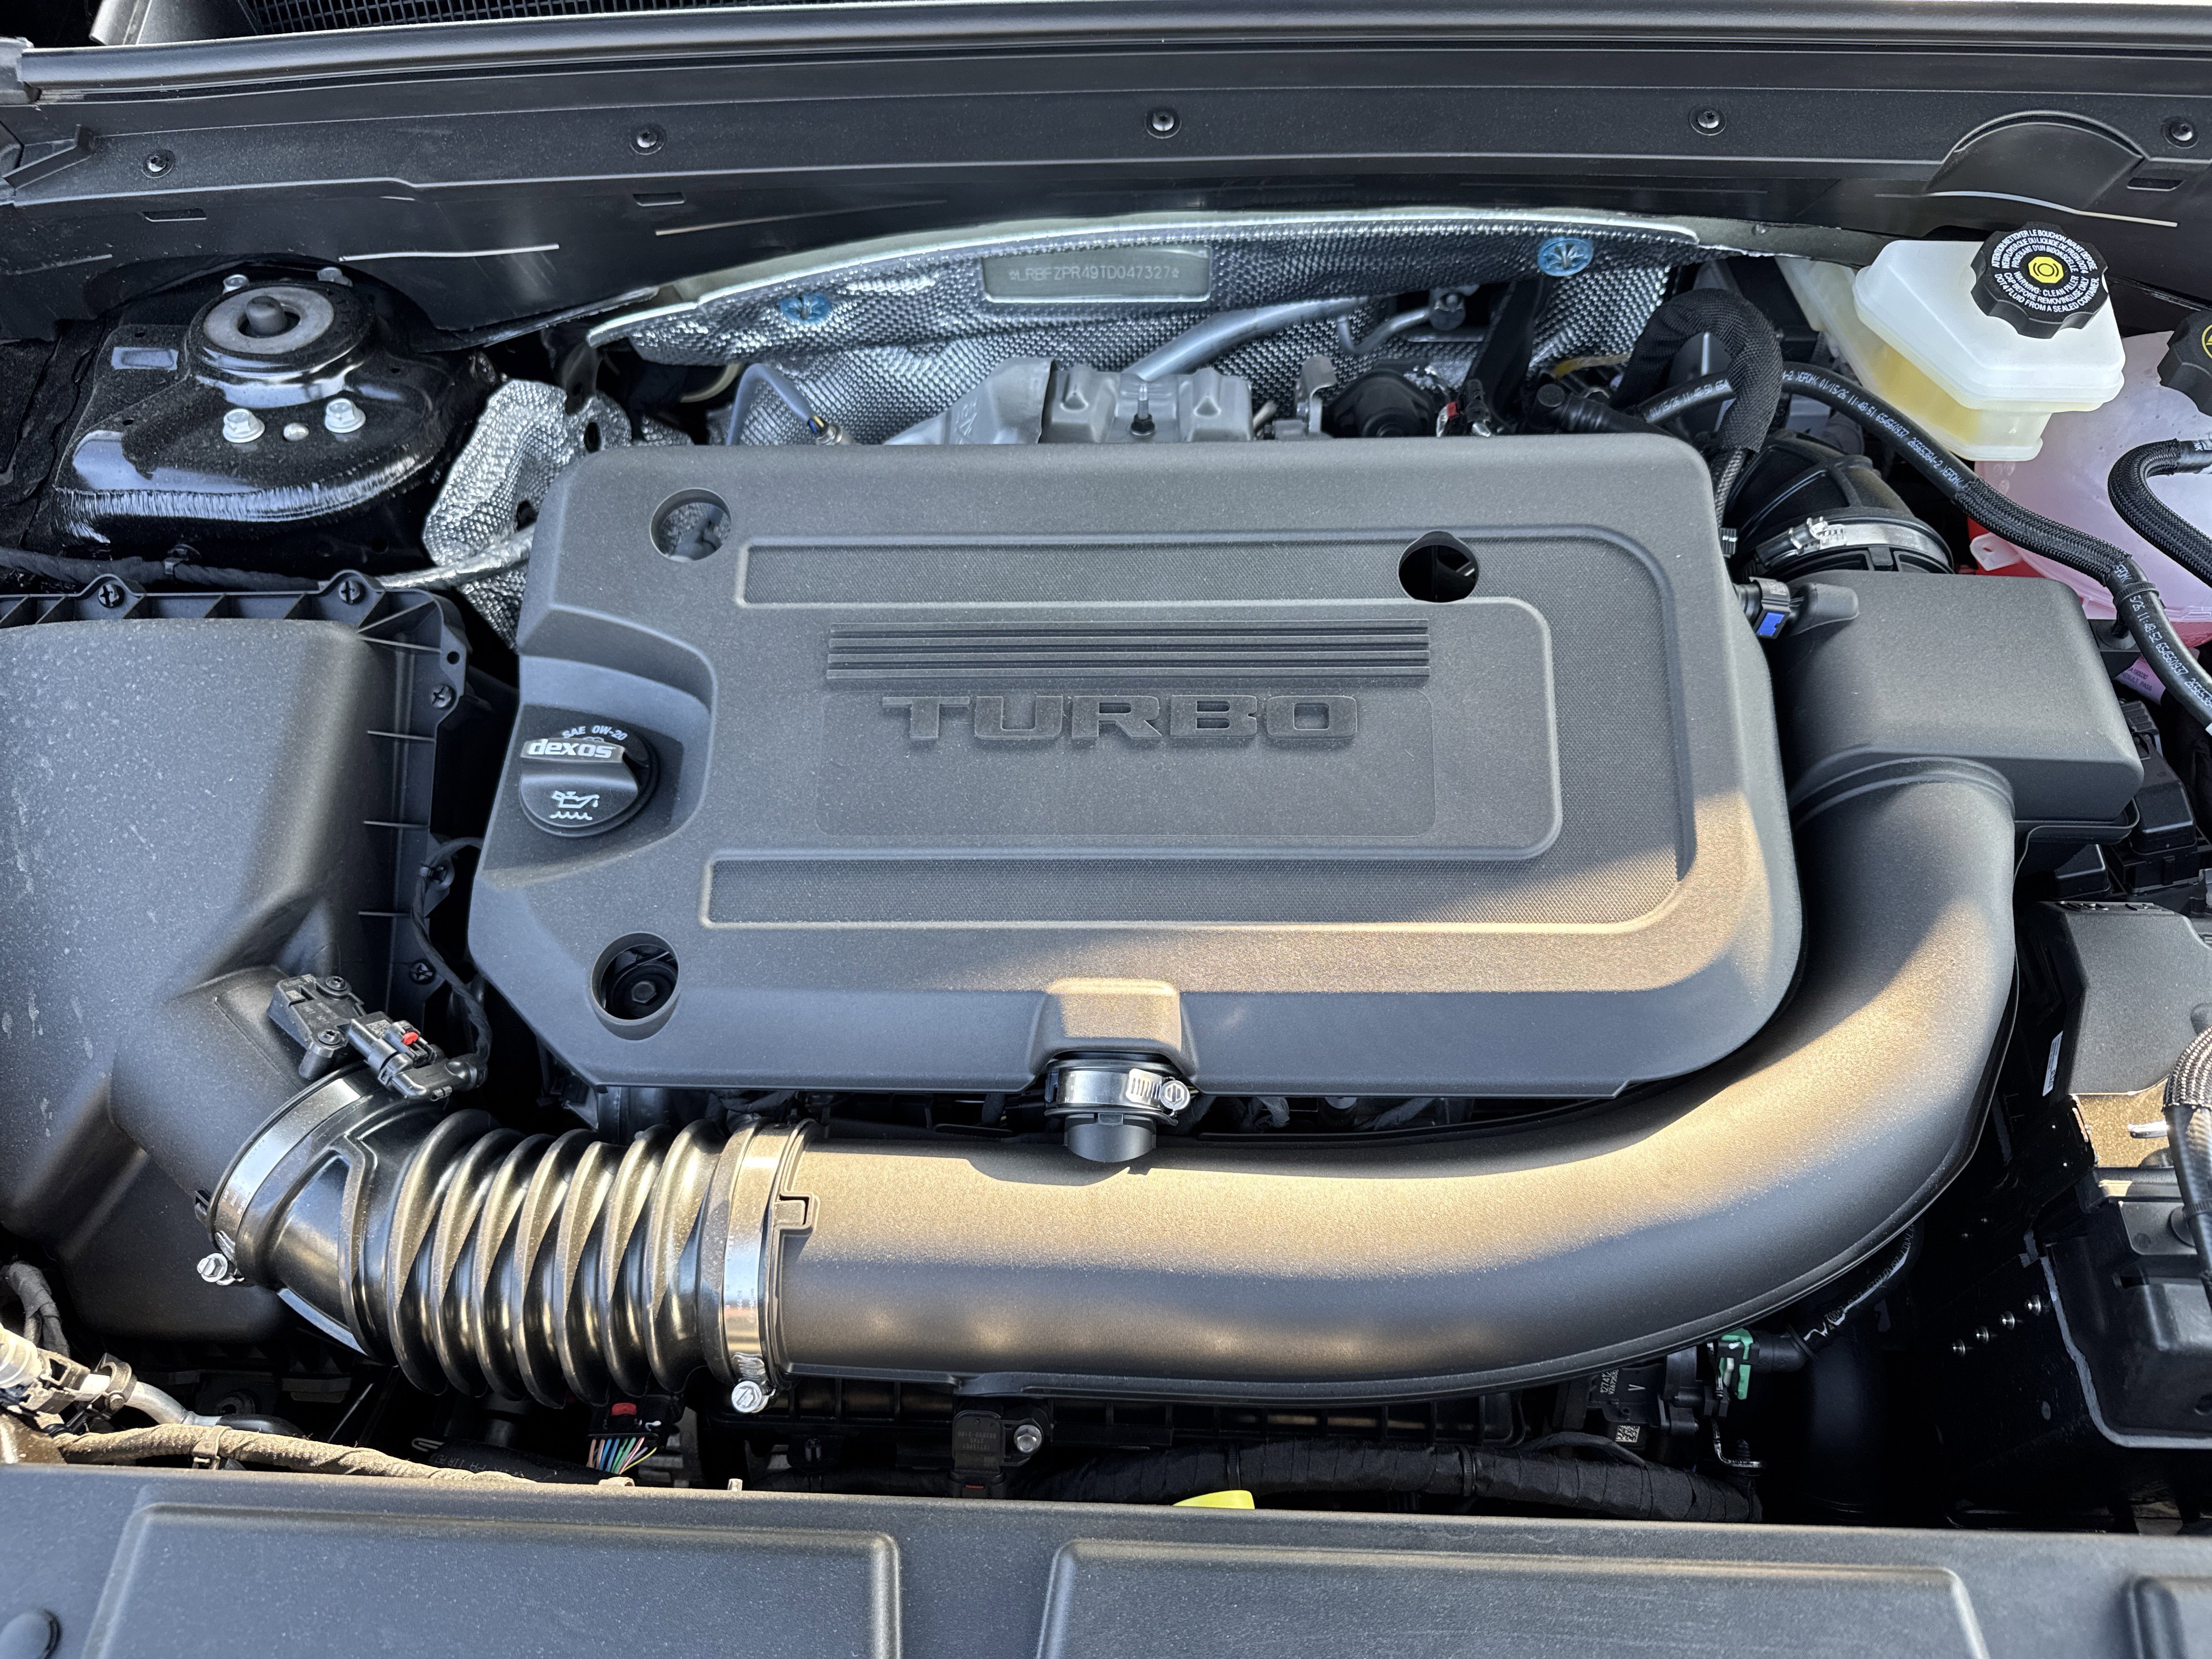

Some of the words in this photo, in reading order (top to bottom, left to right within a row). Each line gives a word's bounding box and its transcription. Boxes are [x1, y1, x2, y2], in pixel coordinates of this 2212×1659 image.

[2036, 237, 2059, 247] LIQUIDE
[2037, 229, 2067, 242] BOUCHON
[2064, 239, 2085, 253] AVANT
[2080, 251, 2098, 271] DEPOSE
[2046, 245, 2064, 257] BIDON
[2004, 272, 2016, 284] CAP
[2012, 283, 2038, 301] BEFORE
[2078, 276, 2089, 291] ONLY
[2005, 287, 2025, 303] FLUID
[2024, 299, 2046, 312] FROM
[2052, 302, 2079, 312] SEALED
[2077, 278, 2100, 306] CONTAINER
[2013, 271, 2041, 295] WARNING:
[2042, 288, 2066, 297] CLEAN
[2063, 275, 2079, 292] FILLER
[882, 695, 1358, 740] TURBO
[562, 725, 586, 738] SAE
[591, 725, 628, 741] 0W-20
[528, 738, 617, 759] dexos
